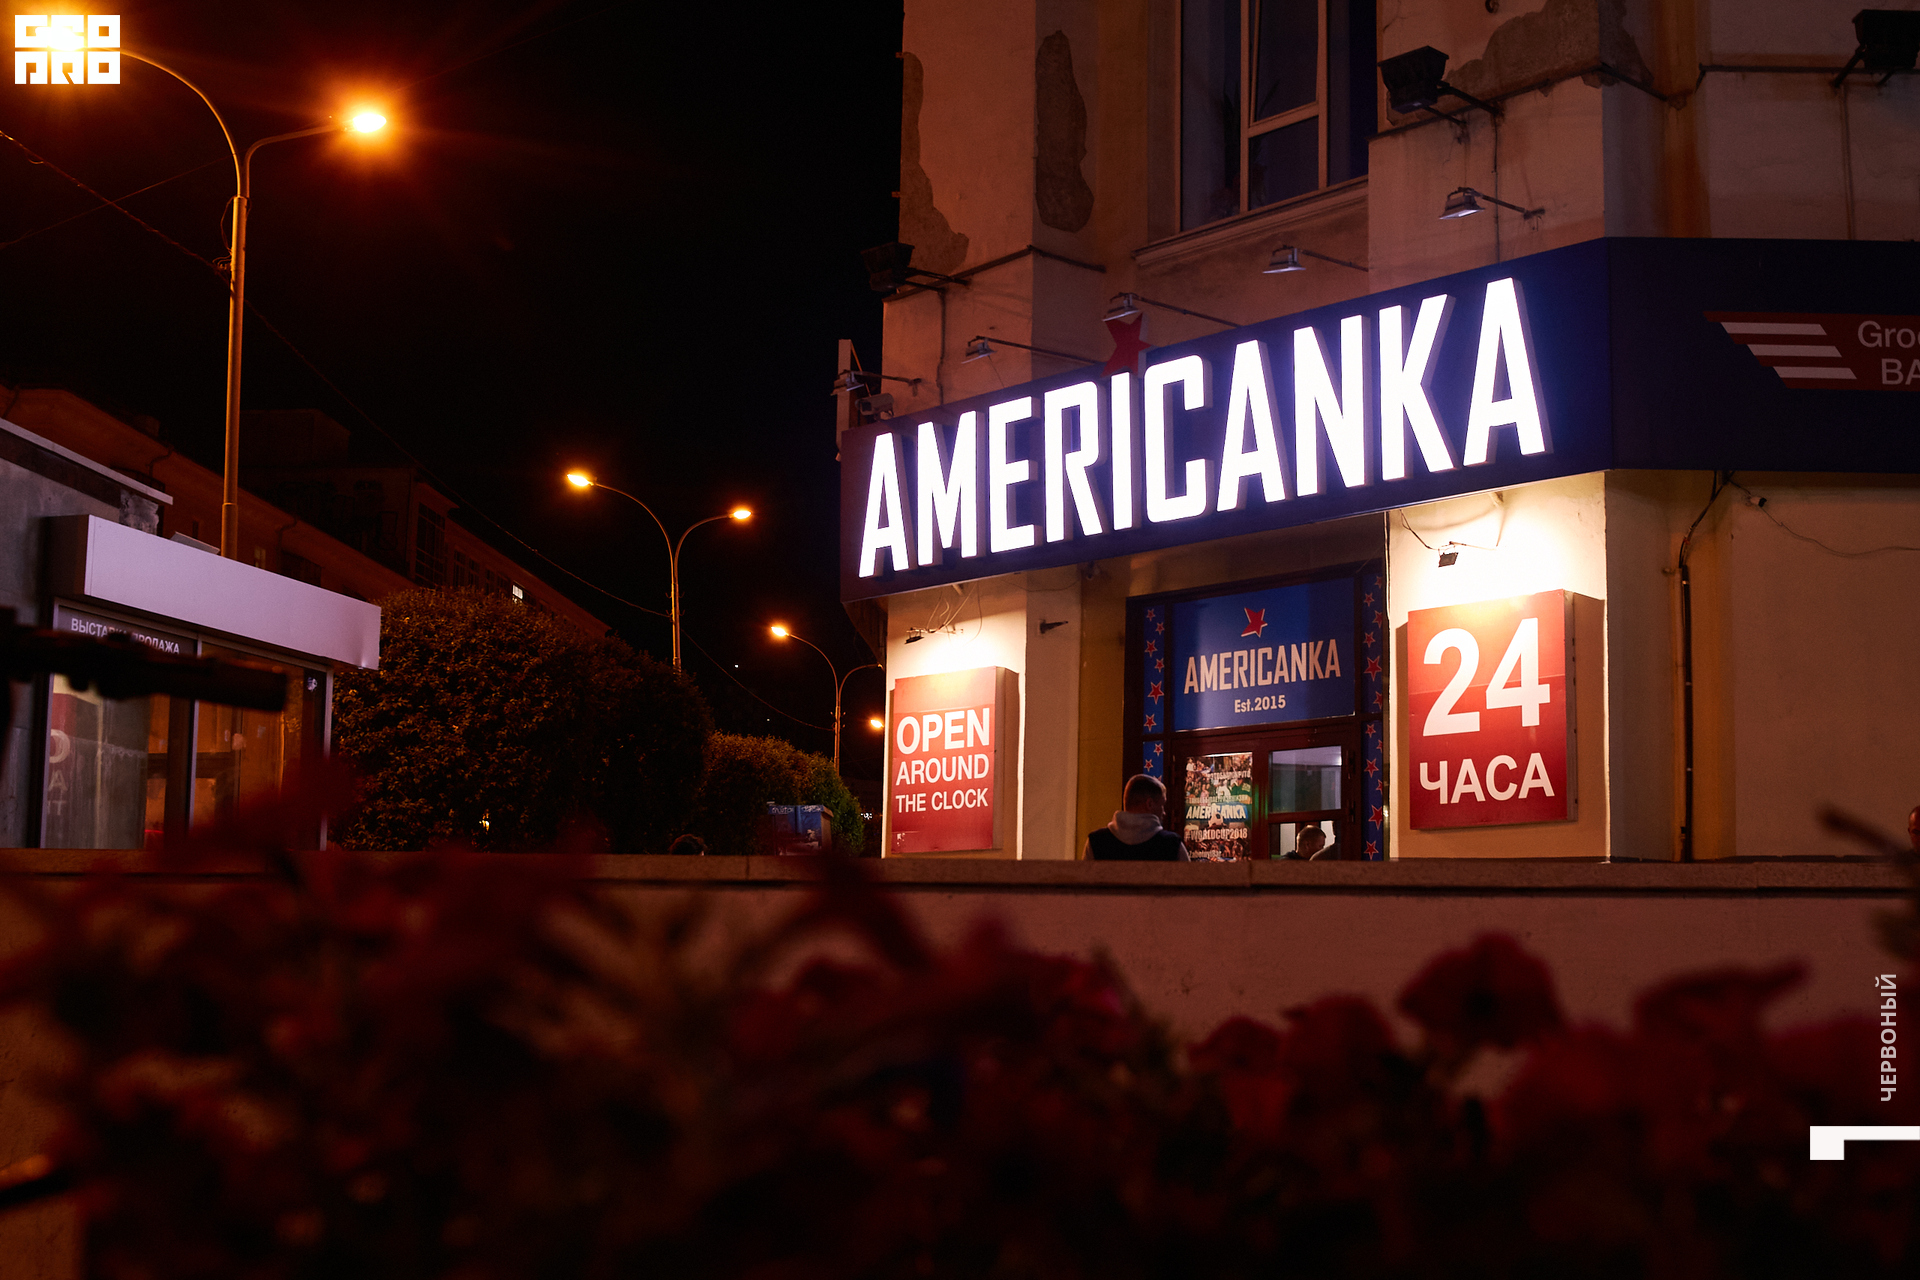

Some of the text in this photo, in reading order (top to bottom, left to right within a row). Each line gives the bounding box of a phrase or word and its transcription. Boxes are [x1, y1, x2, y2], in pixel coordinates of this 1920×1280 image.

[1857, 320, 1920, 349] Gro
[859, 277, 1547, 578] AMERICANKA
[1183, 638, 1342, 694] AMERICANKA
[1422, 617, 1551, 737] 24
[1234, 694, 1287, 713] Est.2015
[896, 707, 990, 755] OPEN
[895, 753, 990, 786] AROUND
[1419, 752, 1556, 805] ЧАСА
[895, 788, 988, 813] THE CLOCK
